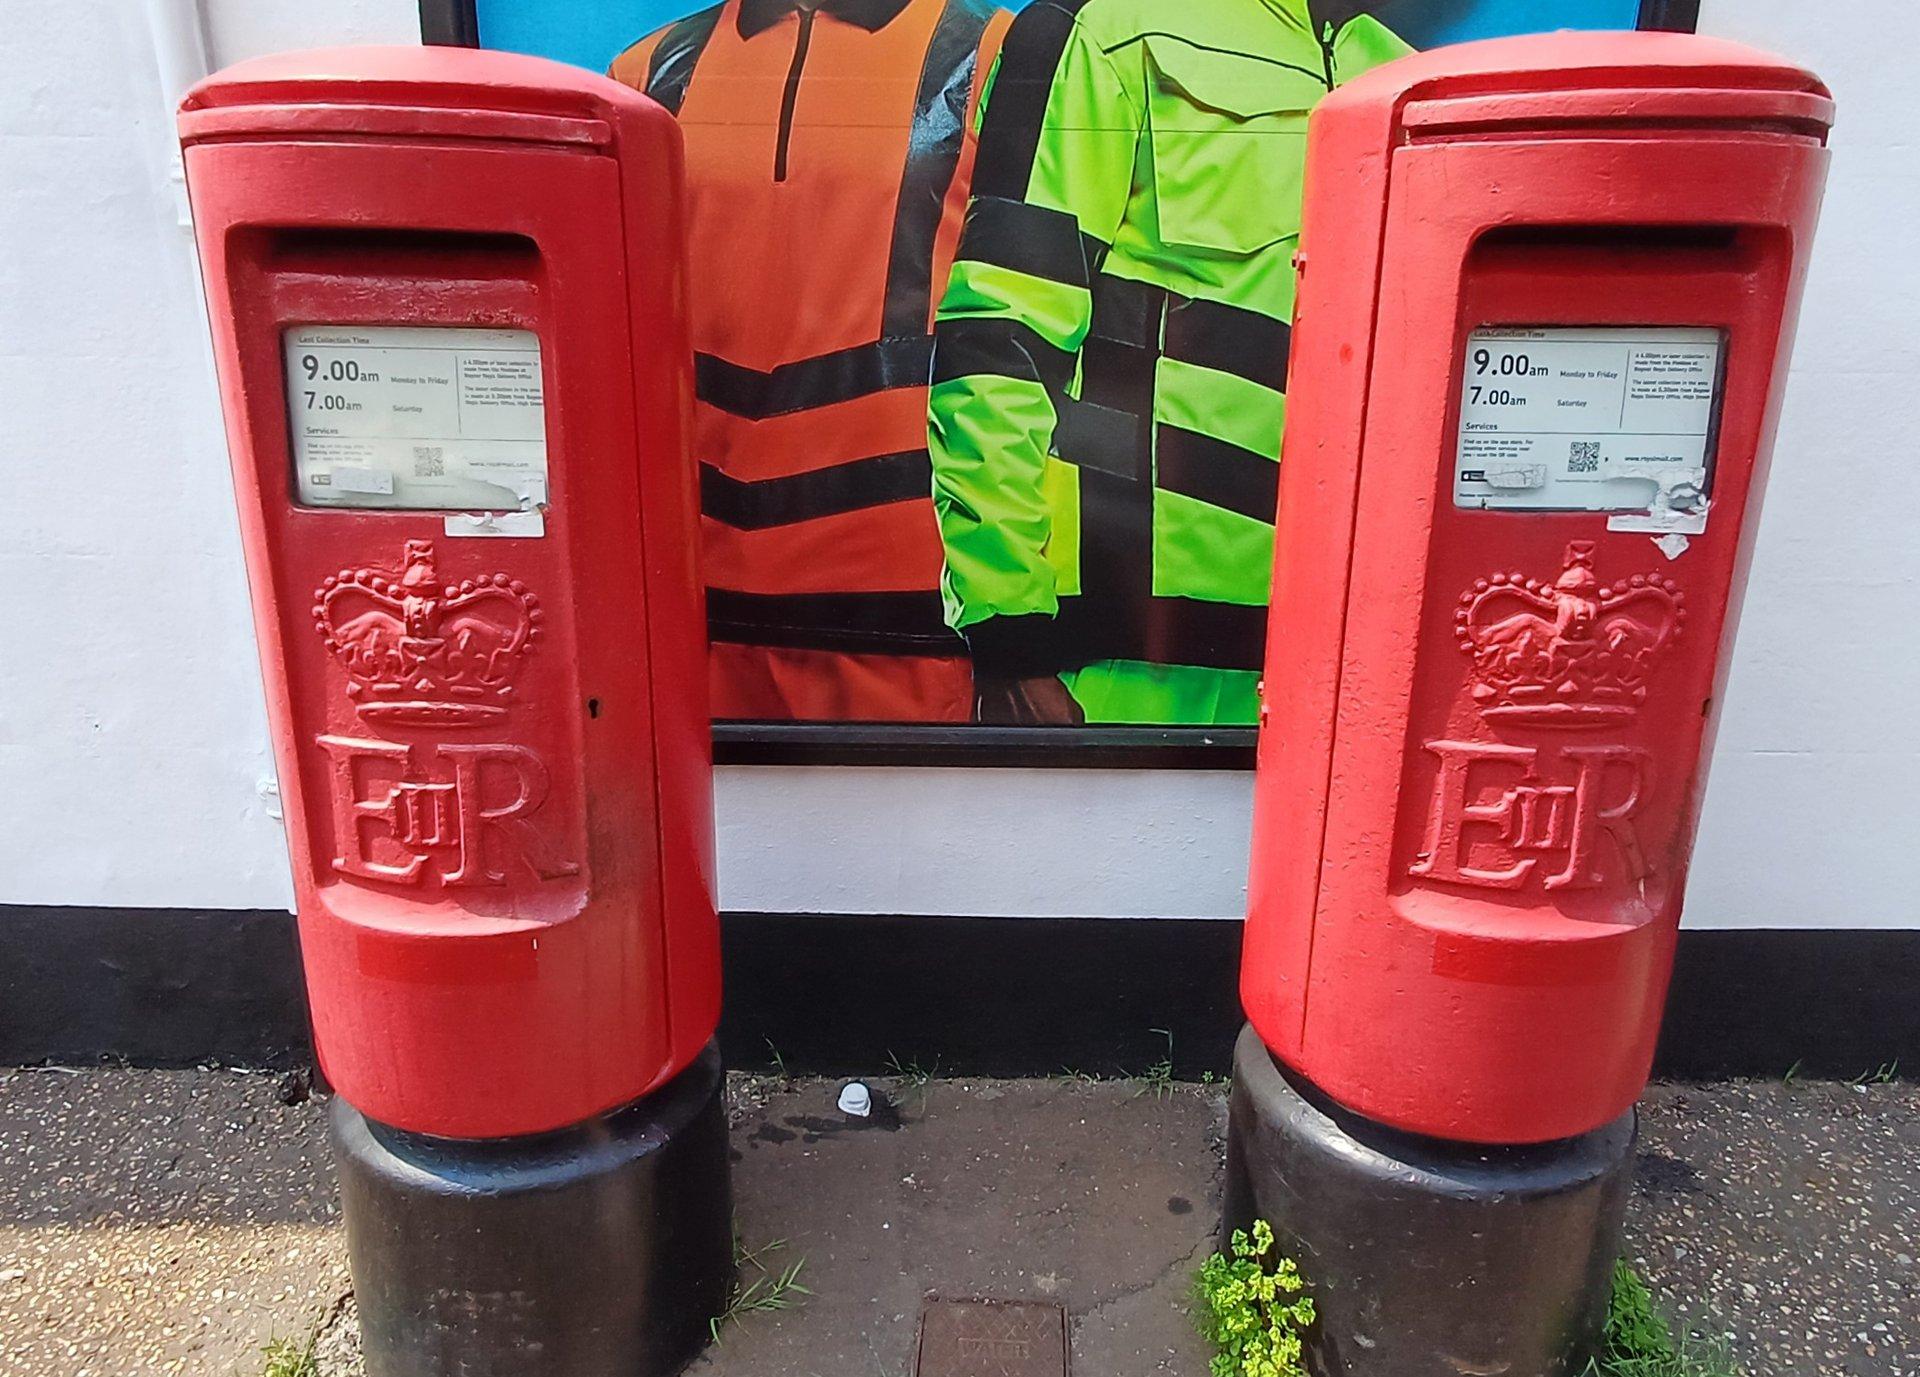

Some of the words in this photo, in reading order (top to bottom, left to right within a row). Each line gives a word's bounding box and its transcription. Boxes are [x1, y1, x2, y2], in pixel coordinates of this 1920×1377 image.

[299, 336, 315, 344] Last
[316, 336, 351, 344] Collection
[1473, 348, 1549, 377] 9.00am
[302, 354, 380, 382] 9.00am
[1560, 370, 1586, 379] Monday
[1596, 371, 1618, 379] Friday
[391, 376, 417, 385] Monday
[427, 377, 449, 386] Friday
[1470, 386, 1526, 406] 7.00am
[304, 391, 362, 411] 7.00am
[1557, 399, 1587, 408] Saturday
[393, 404, 423, 413] Saturday
[306, 426, 339, 435] Services
[1466, 422, 1498, 431] Services
